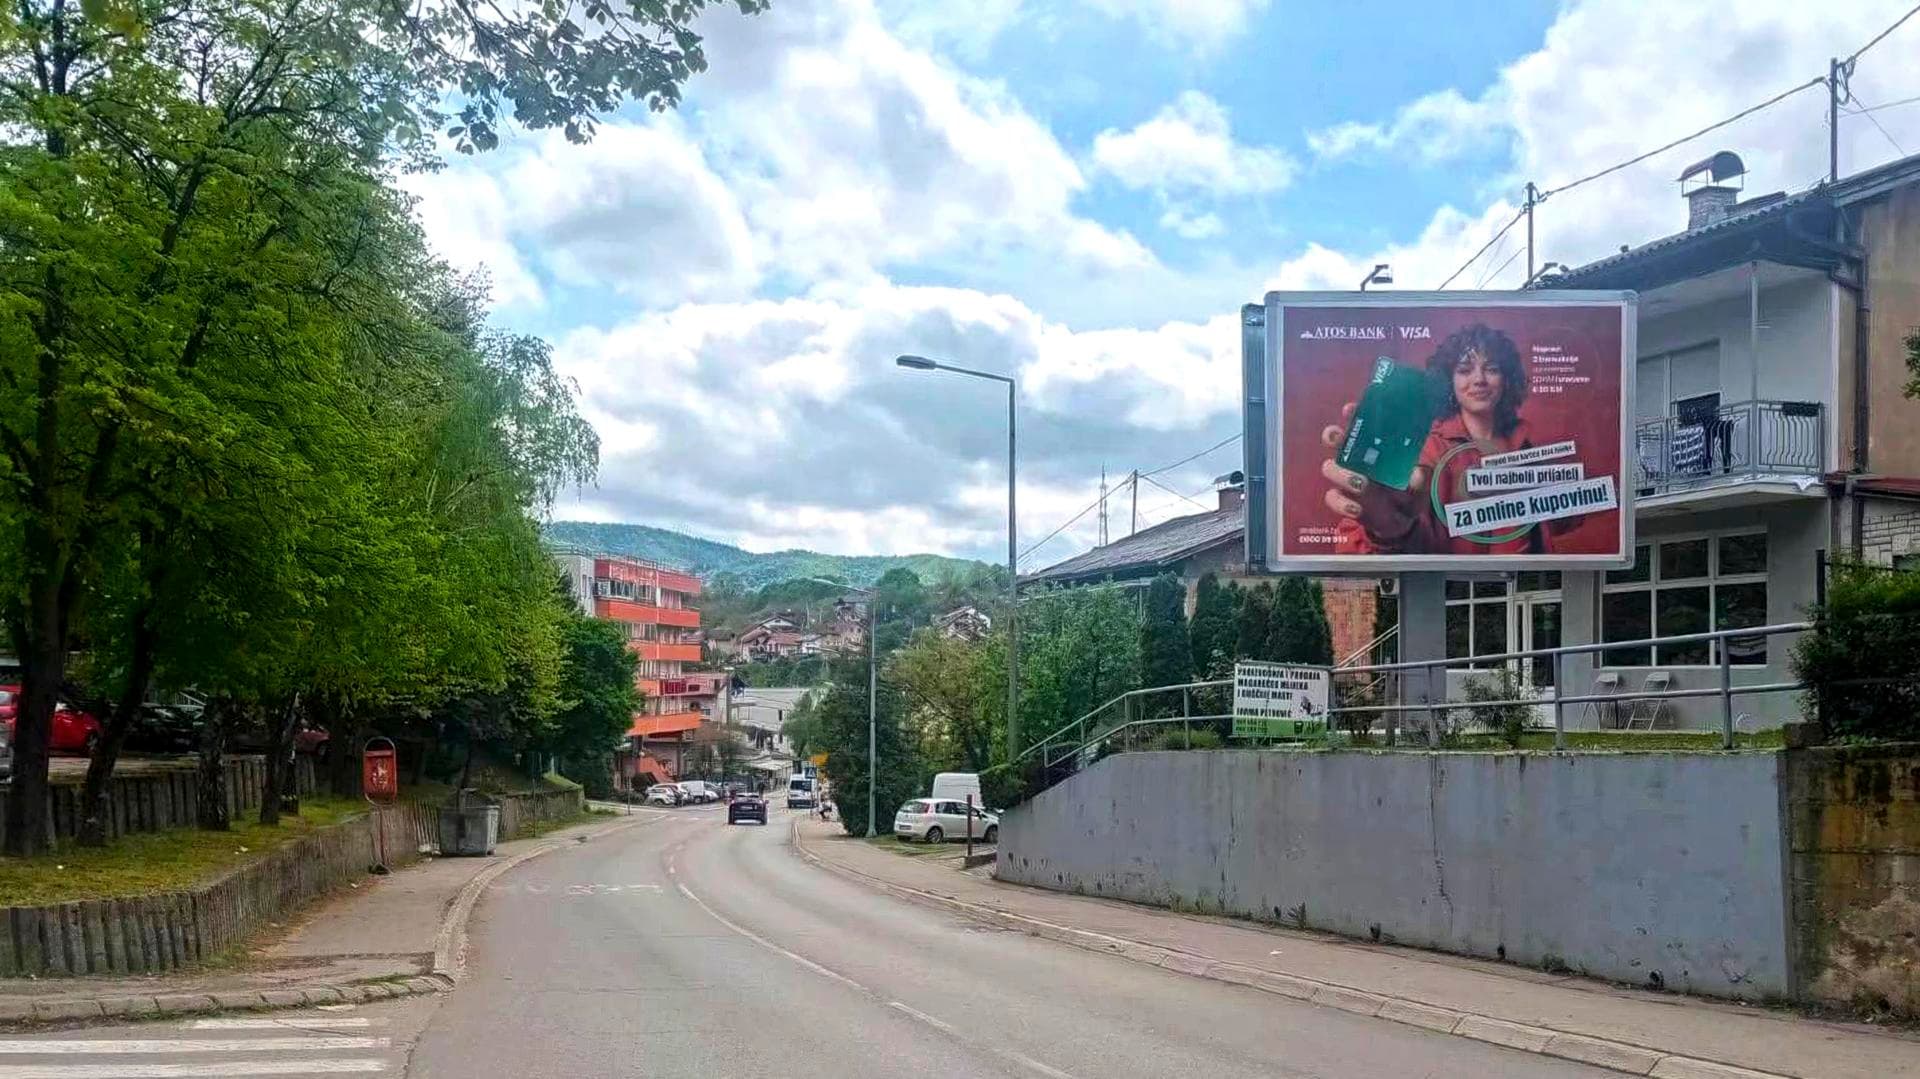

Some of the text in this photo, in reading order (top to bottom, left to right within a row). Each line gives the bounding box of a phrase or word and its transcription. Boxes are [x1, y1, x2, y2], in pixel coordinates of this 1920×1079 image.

[1314, 327, 1386, 339] ATOS BANK
[1400, 327, 1431, 339] VISA
[1372, 358, 1391, 384] VISA
[1471, 467, 1580, 487] Tvoj najbolji prijatelj
[1454, 484, 1609, 528] za online kupovinu!
